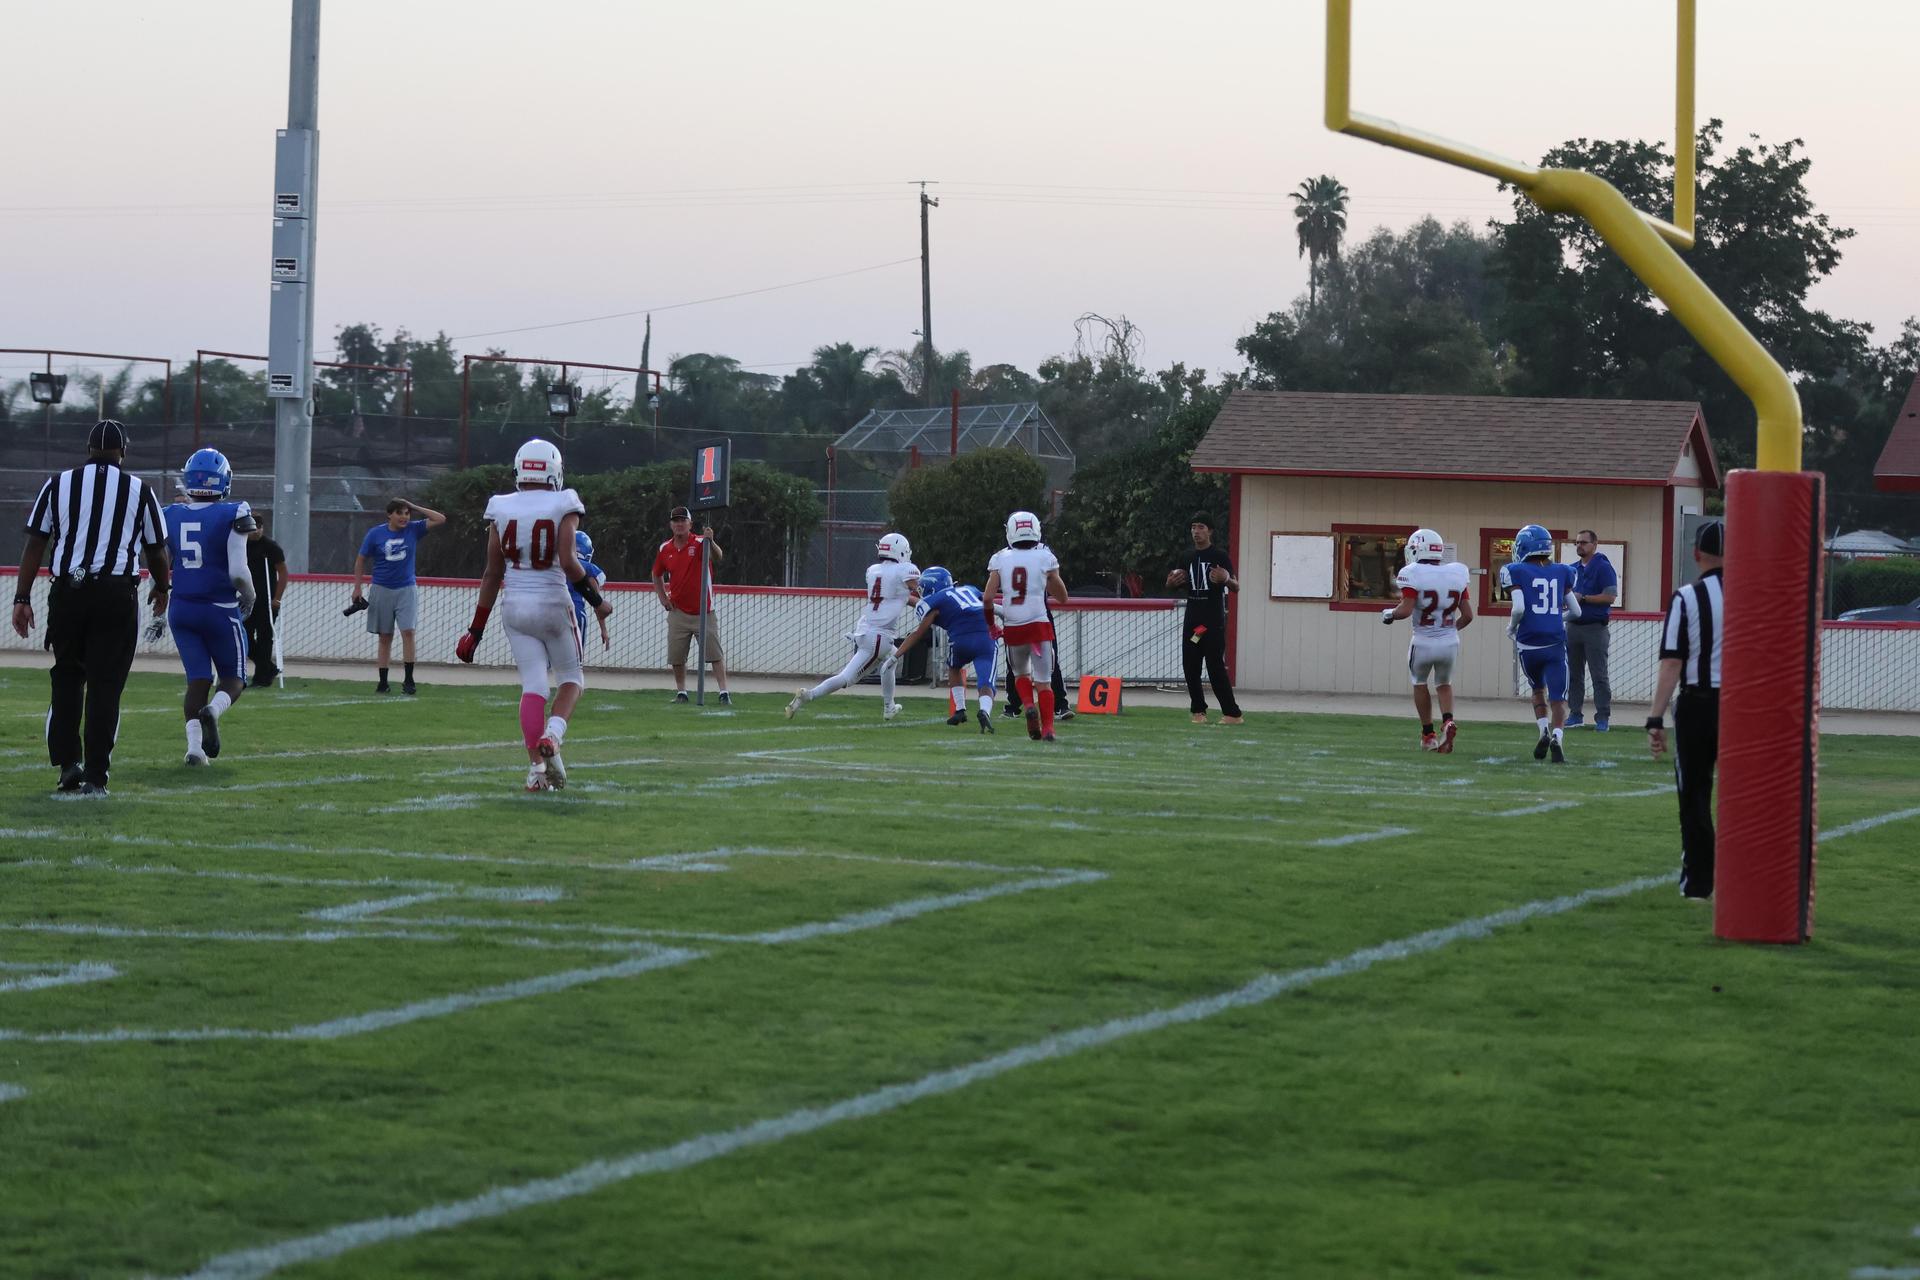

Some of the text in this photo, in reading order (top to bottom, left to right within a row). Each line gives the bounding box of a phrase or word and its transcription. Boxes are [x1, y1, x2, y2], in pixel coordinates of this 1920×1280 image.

[702, 447, 715, 483] 1
[180, 522, 203, 569] 5
[501, 519, 555, 570] 40
[870, 576, 884, 611] 4
[946, 585, 985, 610] 10
[1011, 566, 1028, 605] 9
[1531, 578, 1559, 615] 31
[1418, 590, 1460, 627] 22
[1089, 679, 1109, 707] G
